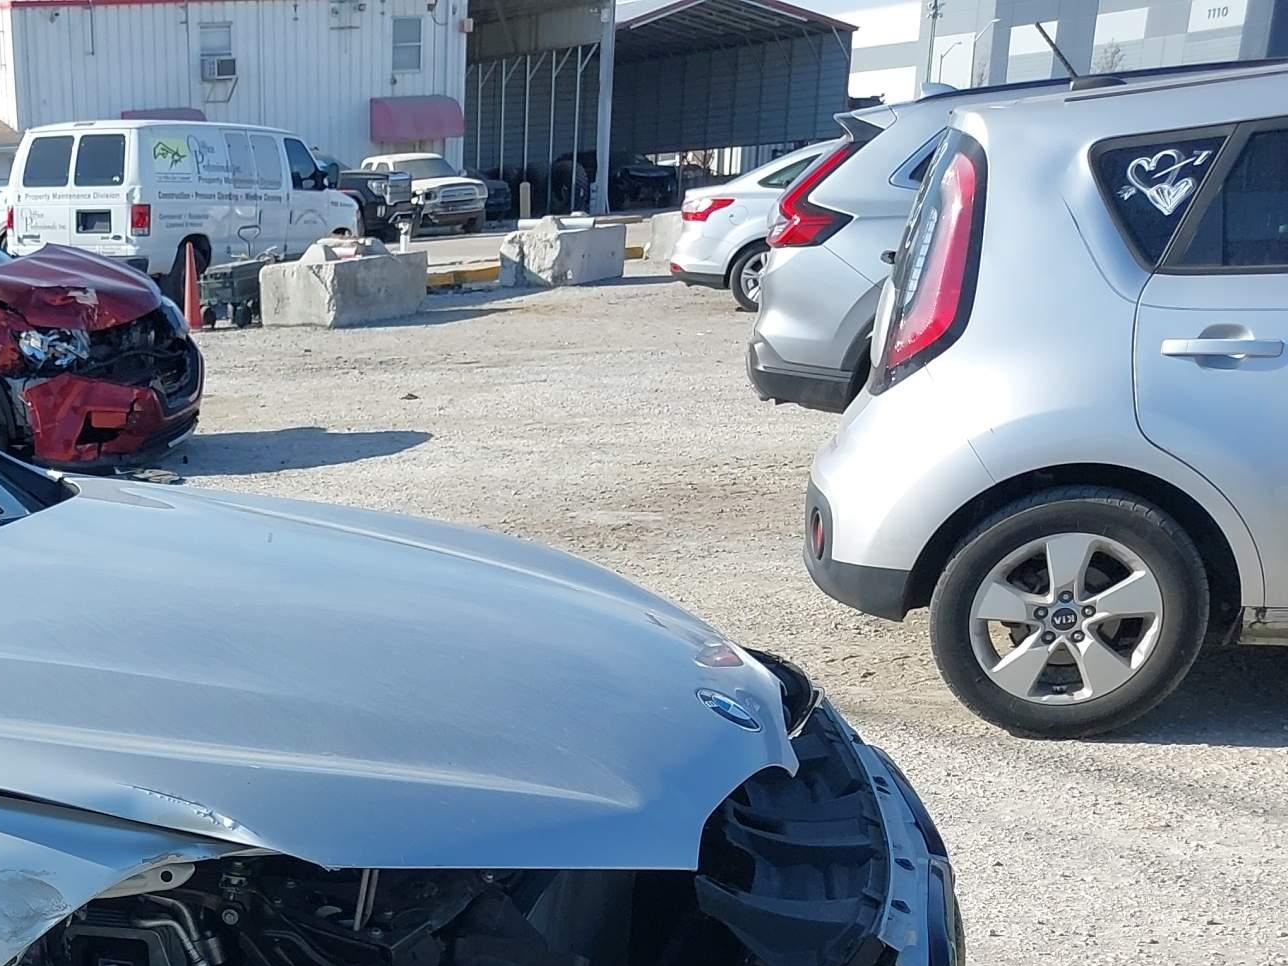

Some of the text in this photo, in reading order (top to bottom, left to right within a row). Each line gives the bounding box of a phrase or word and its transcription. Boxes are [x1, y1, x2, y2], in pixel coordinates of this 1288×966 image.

[1207, 6, 1229, 20] 1110
[24, 191, 120, 201] Property Maintenance Division
[1053, 614, 1075, 625] KIA
